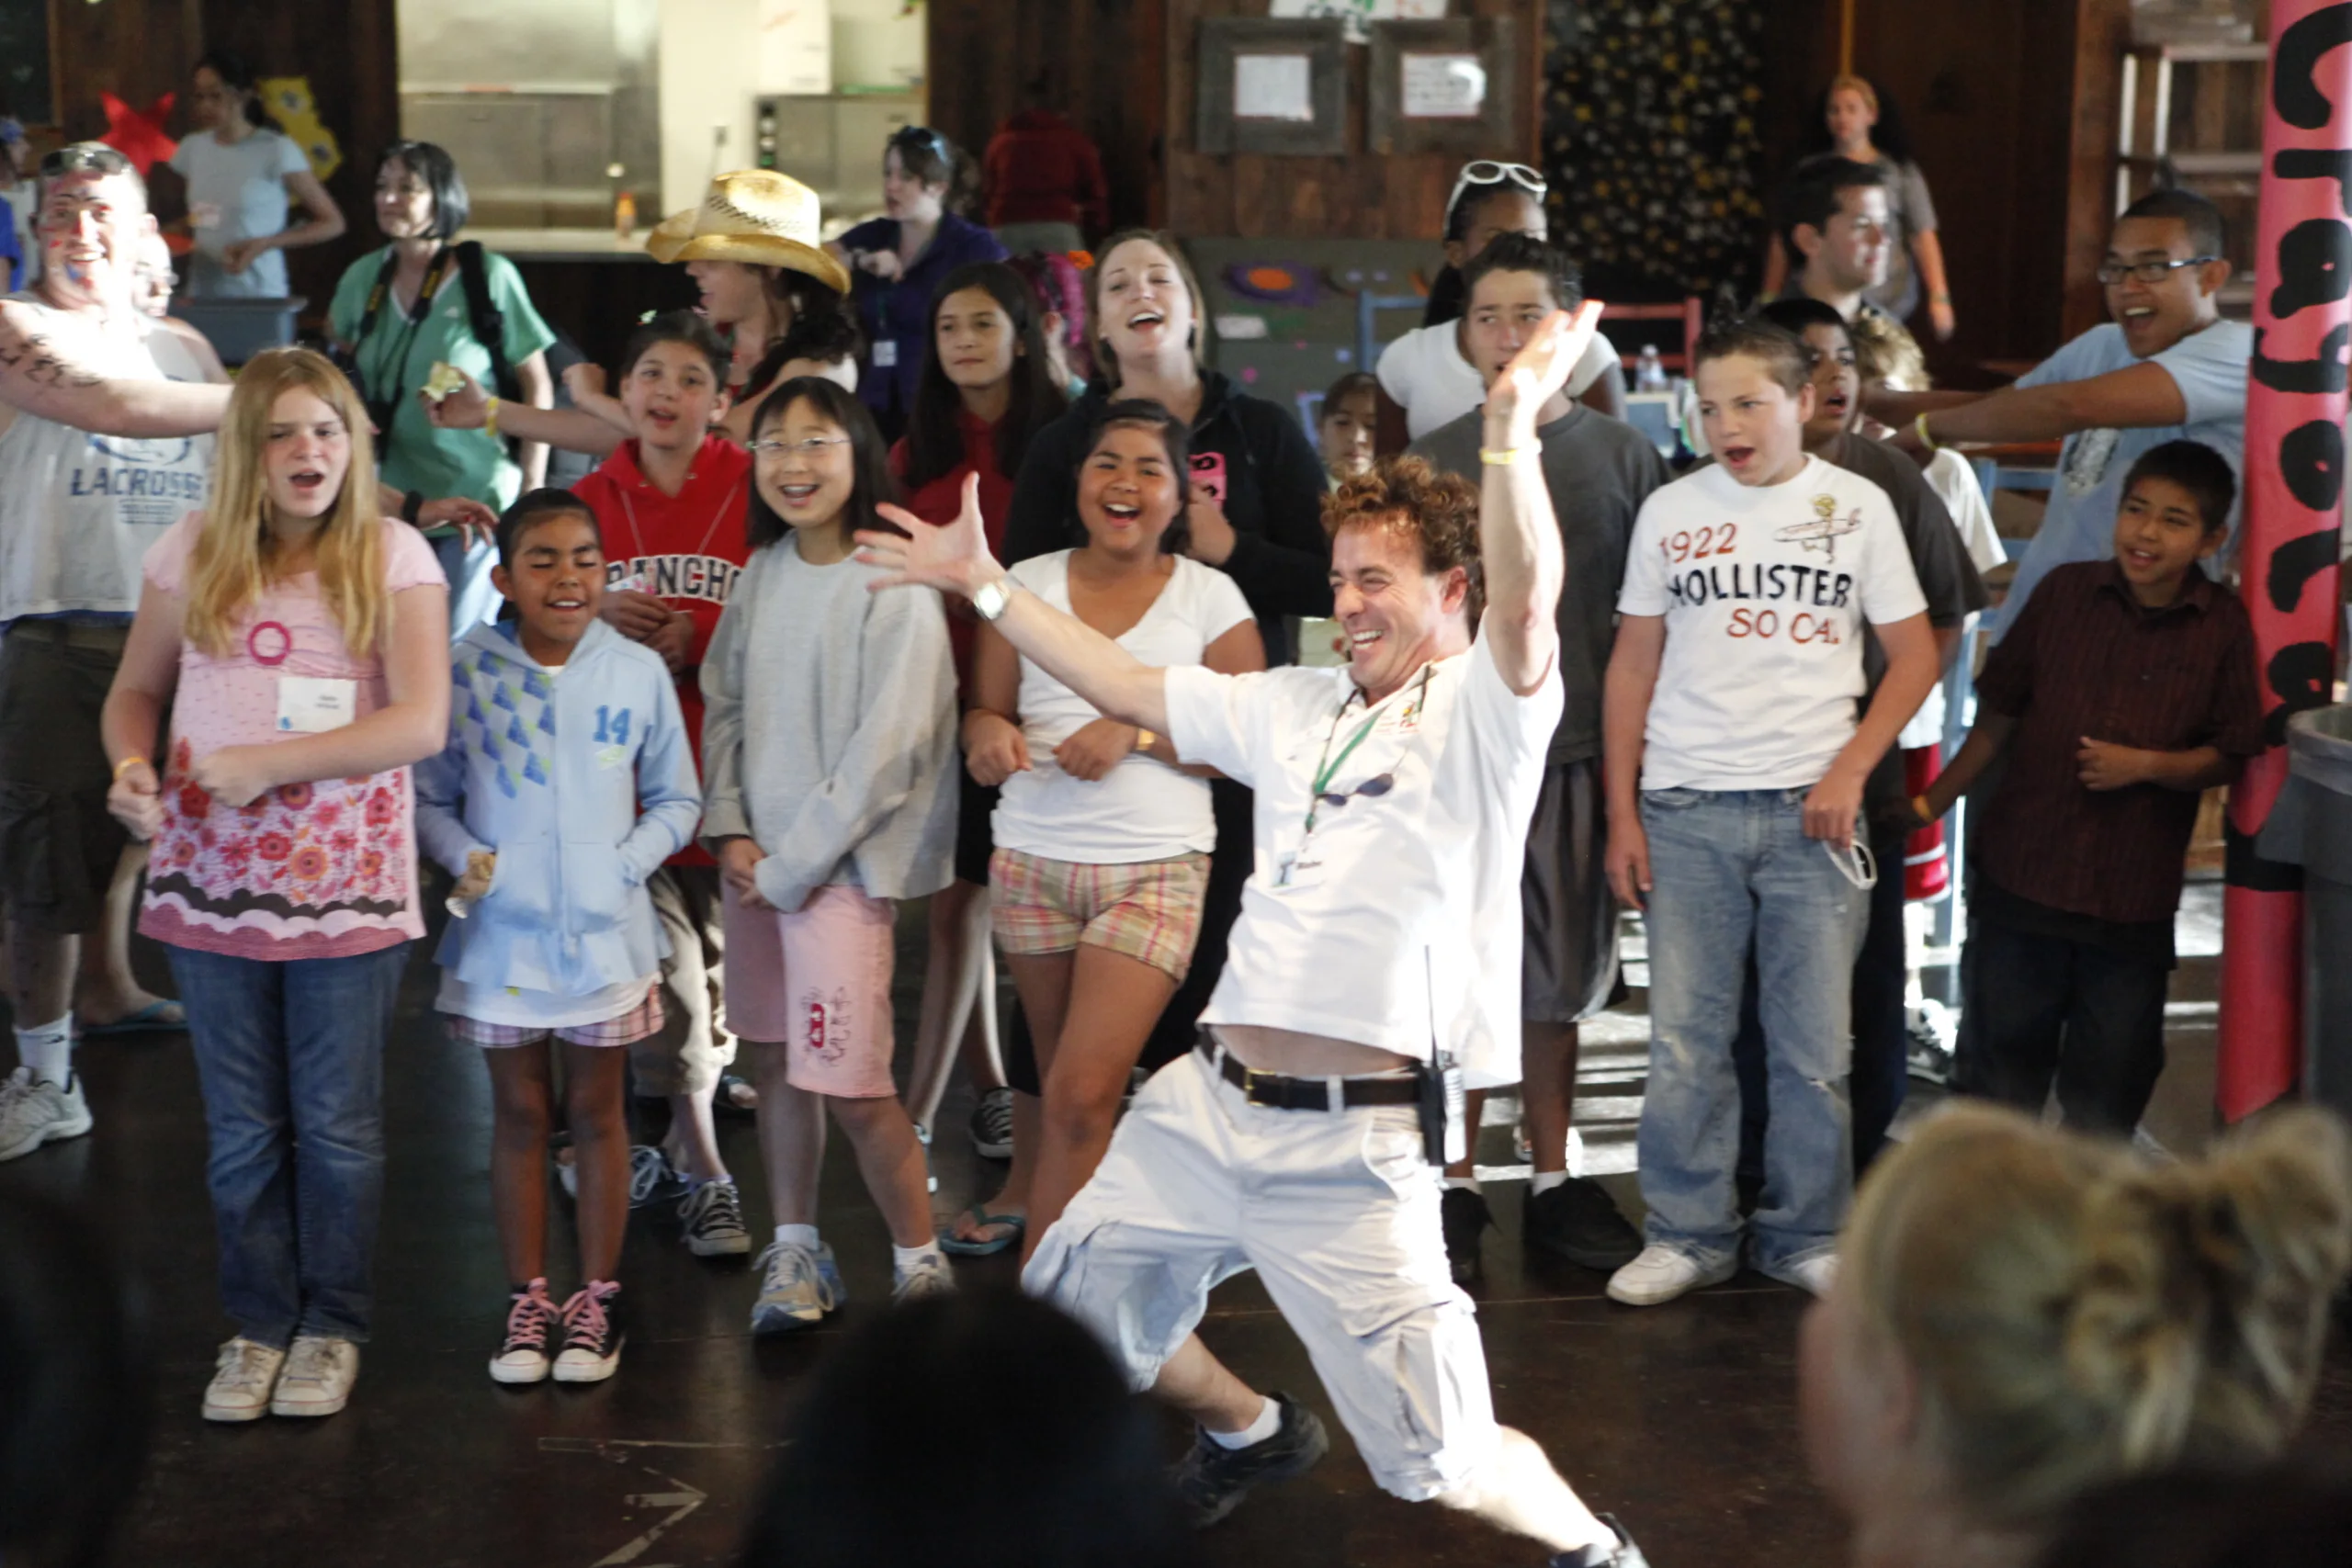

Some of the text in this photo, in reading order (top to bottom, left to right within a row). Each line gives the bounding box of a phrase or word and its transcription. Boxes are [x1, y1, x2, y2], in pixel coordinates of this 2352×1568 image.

[70, 467, 214, 501] LACROSS
[1659, 522, 1739, 565] 1922
[1726, 607, 1780, 639] SO
[592, 705, 631, 747] 14
